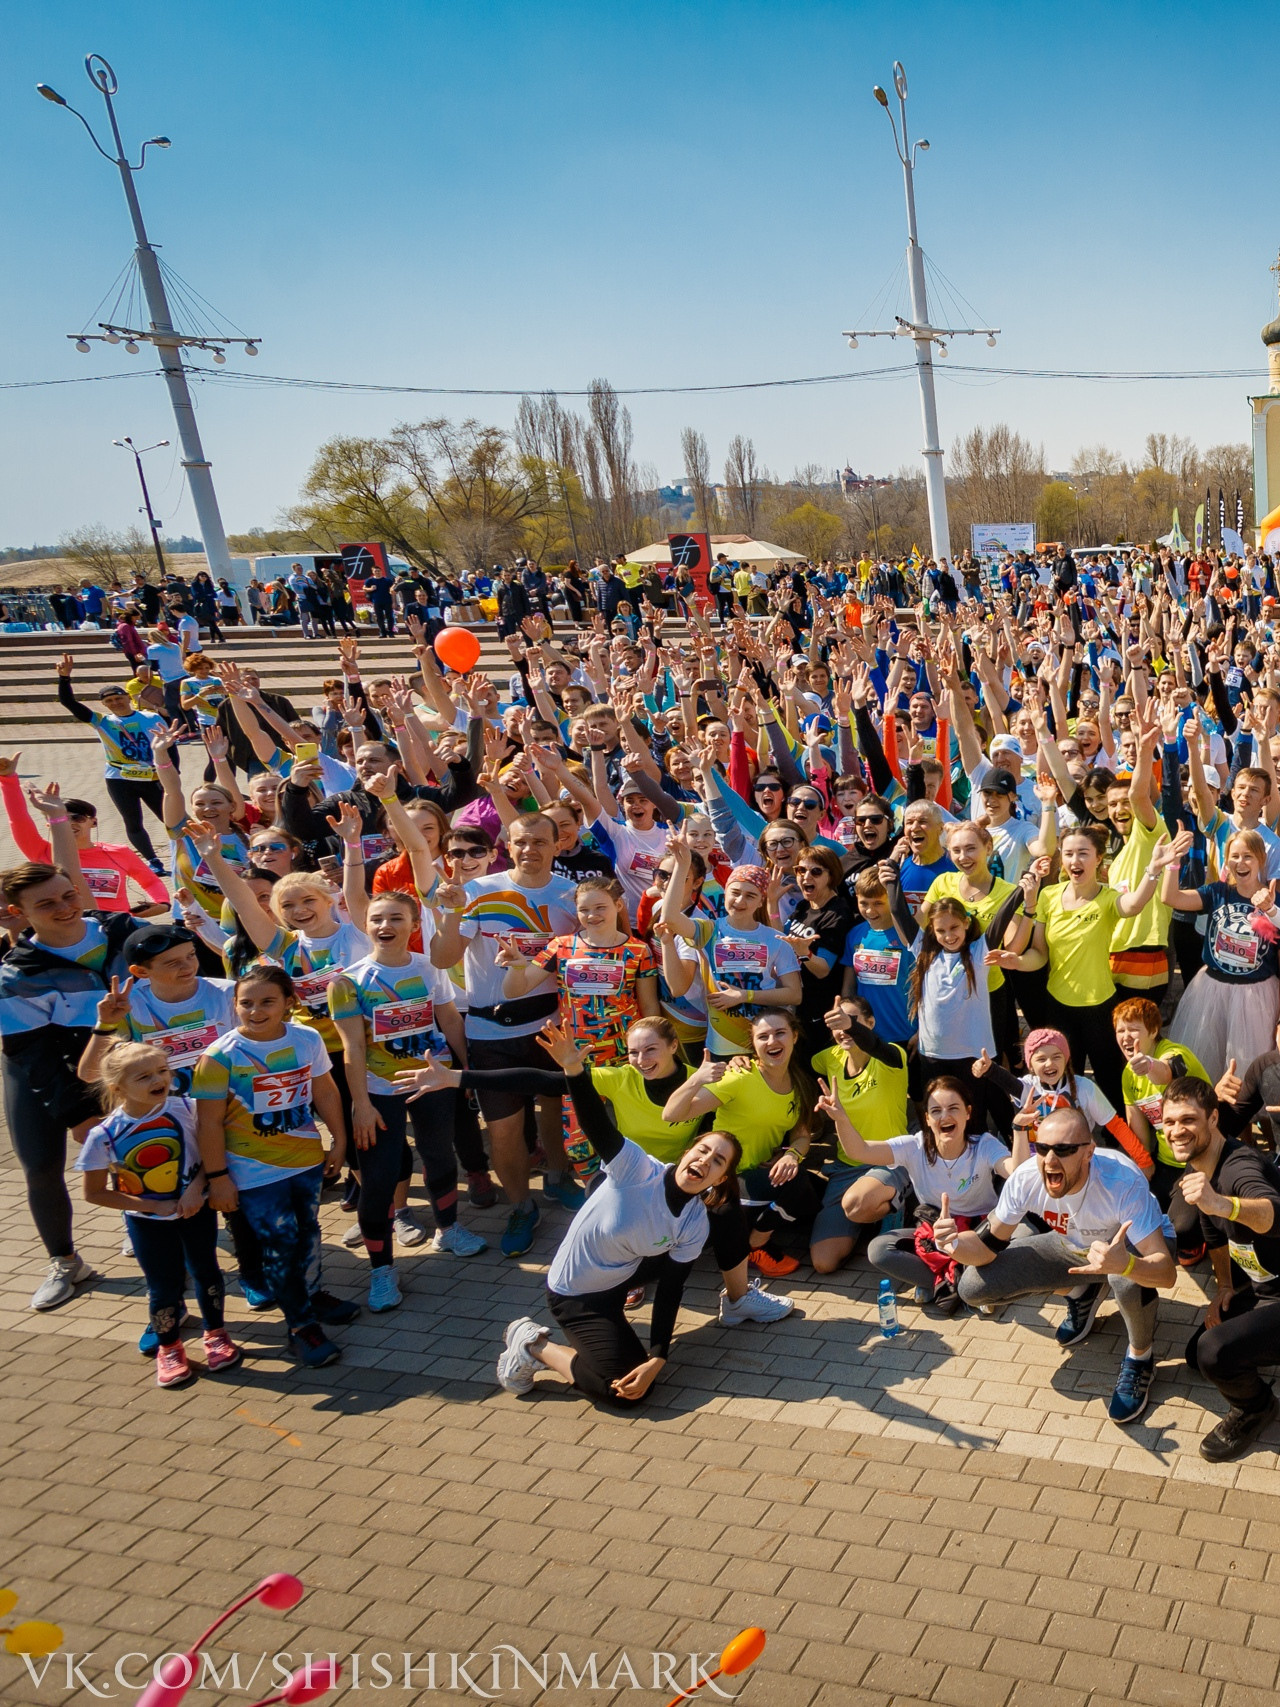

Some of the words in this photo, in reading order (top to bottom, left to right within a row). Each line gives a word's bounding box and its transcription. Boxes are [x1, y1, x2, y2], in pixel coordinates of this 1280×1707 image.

[90, 879, 109, 888] 12
[727, 951, 756, 961] 932
[1222, 942, 1246, 957] 310
[862, 962, 887, 974] 348
[578, 972, 610, 983] 933
[390, 1011, 423, 1027] 602
[164, 1037, 204, 1057] 936
[267, 1083, 309, 1108] 274
